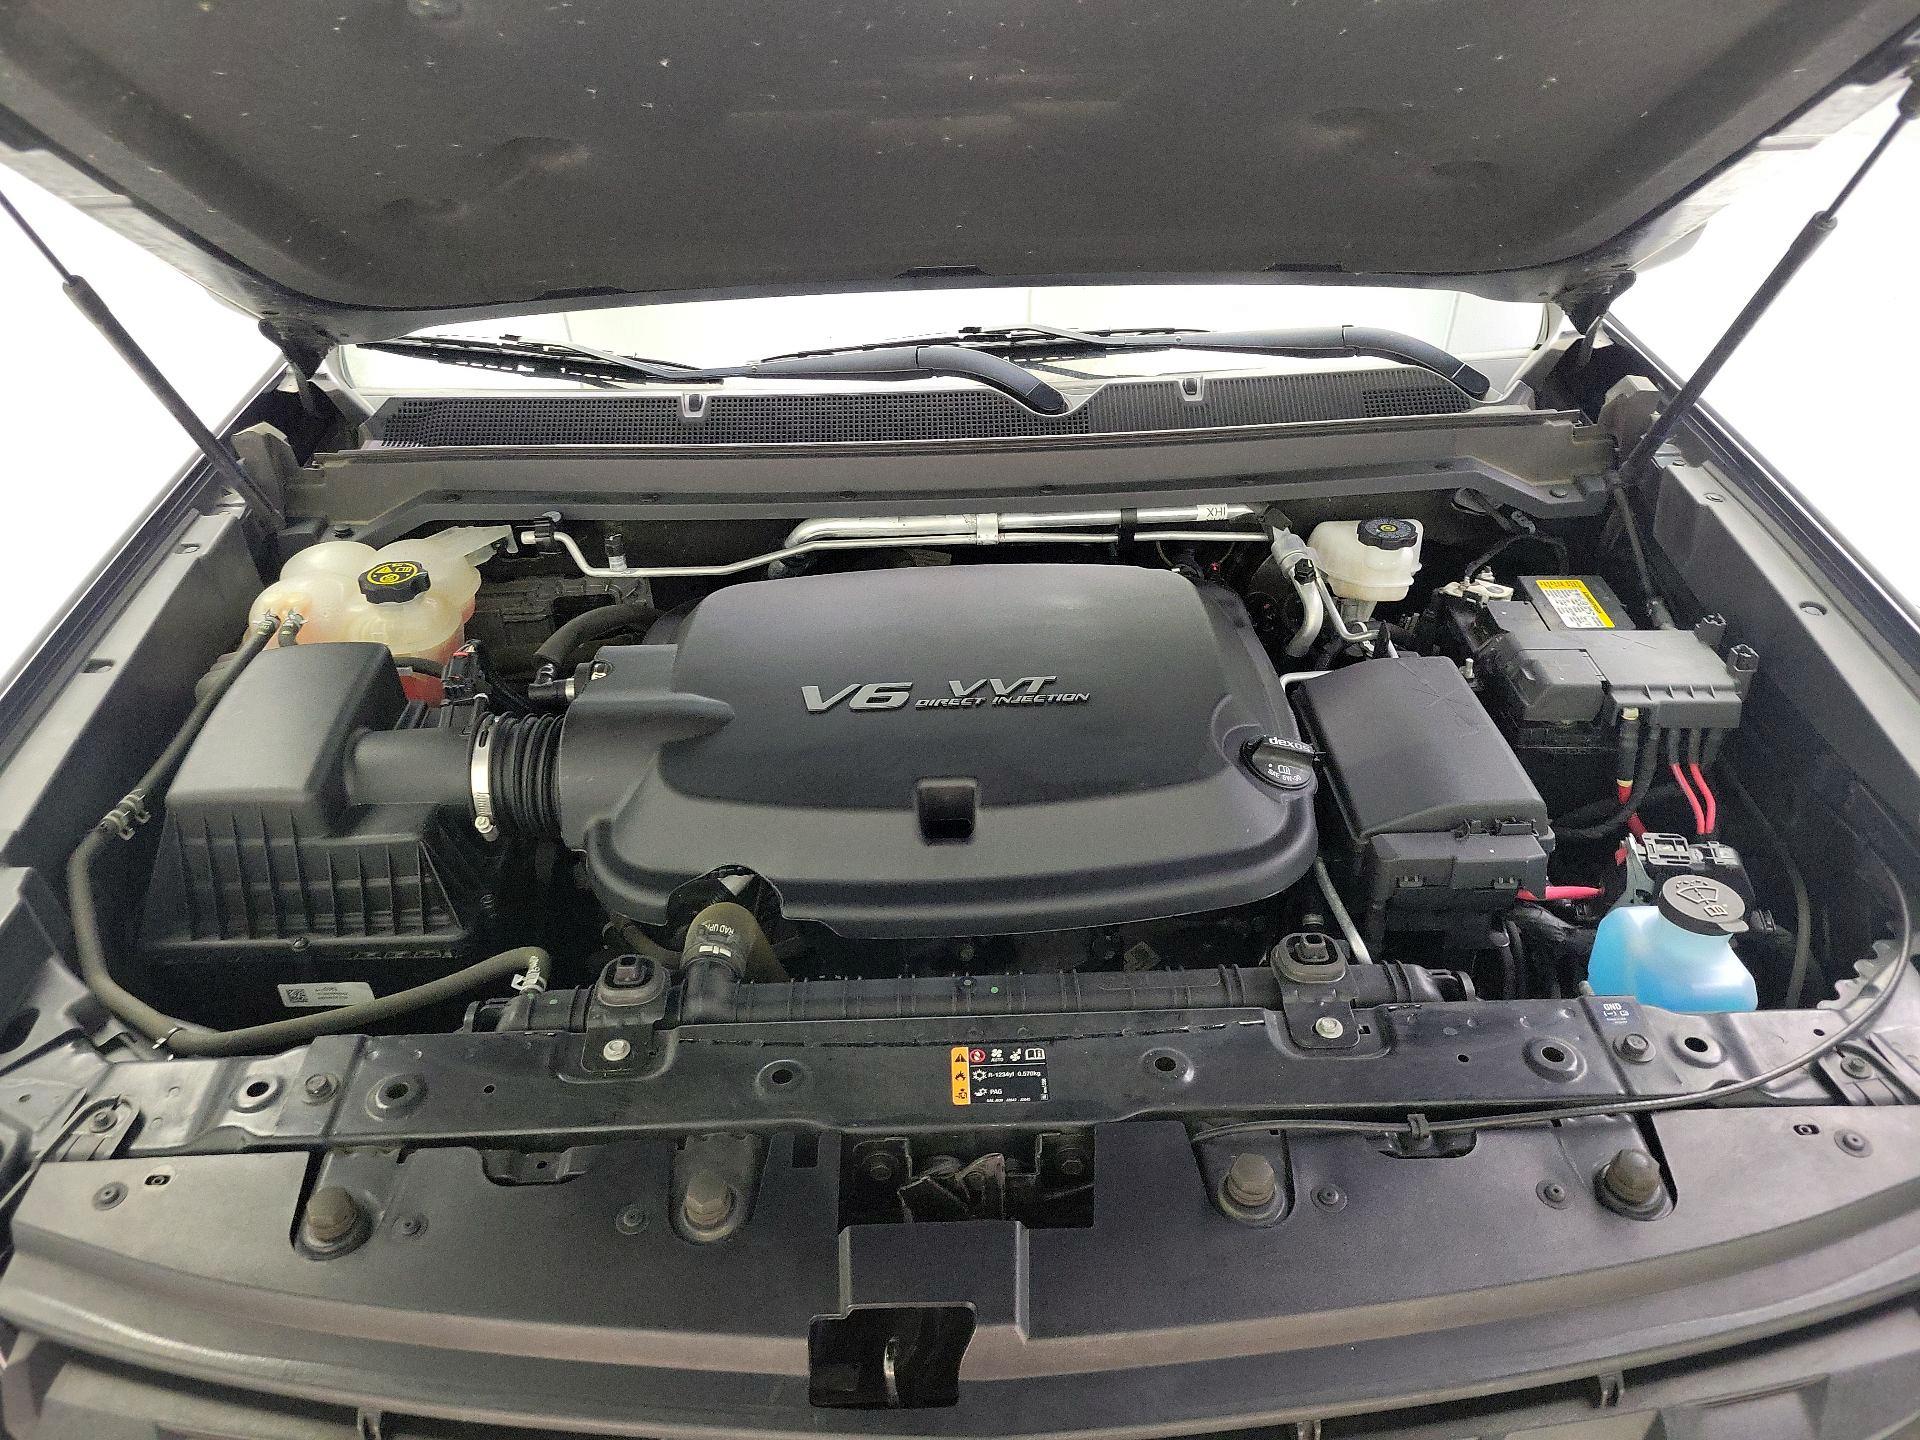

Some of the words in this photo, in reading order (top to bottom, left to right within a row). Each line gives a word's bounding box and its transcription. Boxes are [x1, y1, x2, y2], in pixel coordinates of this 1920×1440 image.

[1206, 506, 1226, 518] XHI
[949, 676, 1058, 698] VVT
[801, 682, 913, 713] V6
[915, 697, 987, 711] DIRECT
[992, 693, 1091, 706] INJECTION
[1268, 736, 1311, 753] dexos
